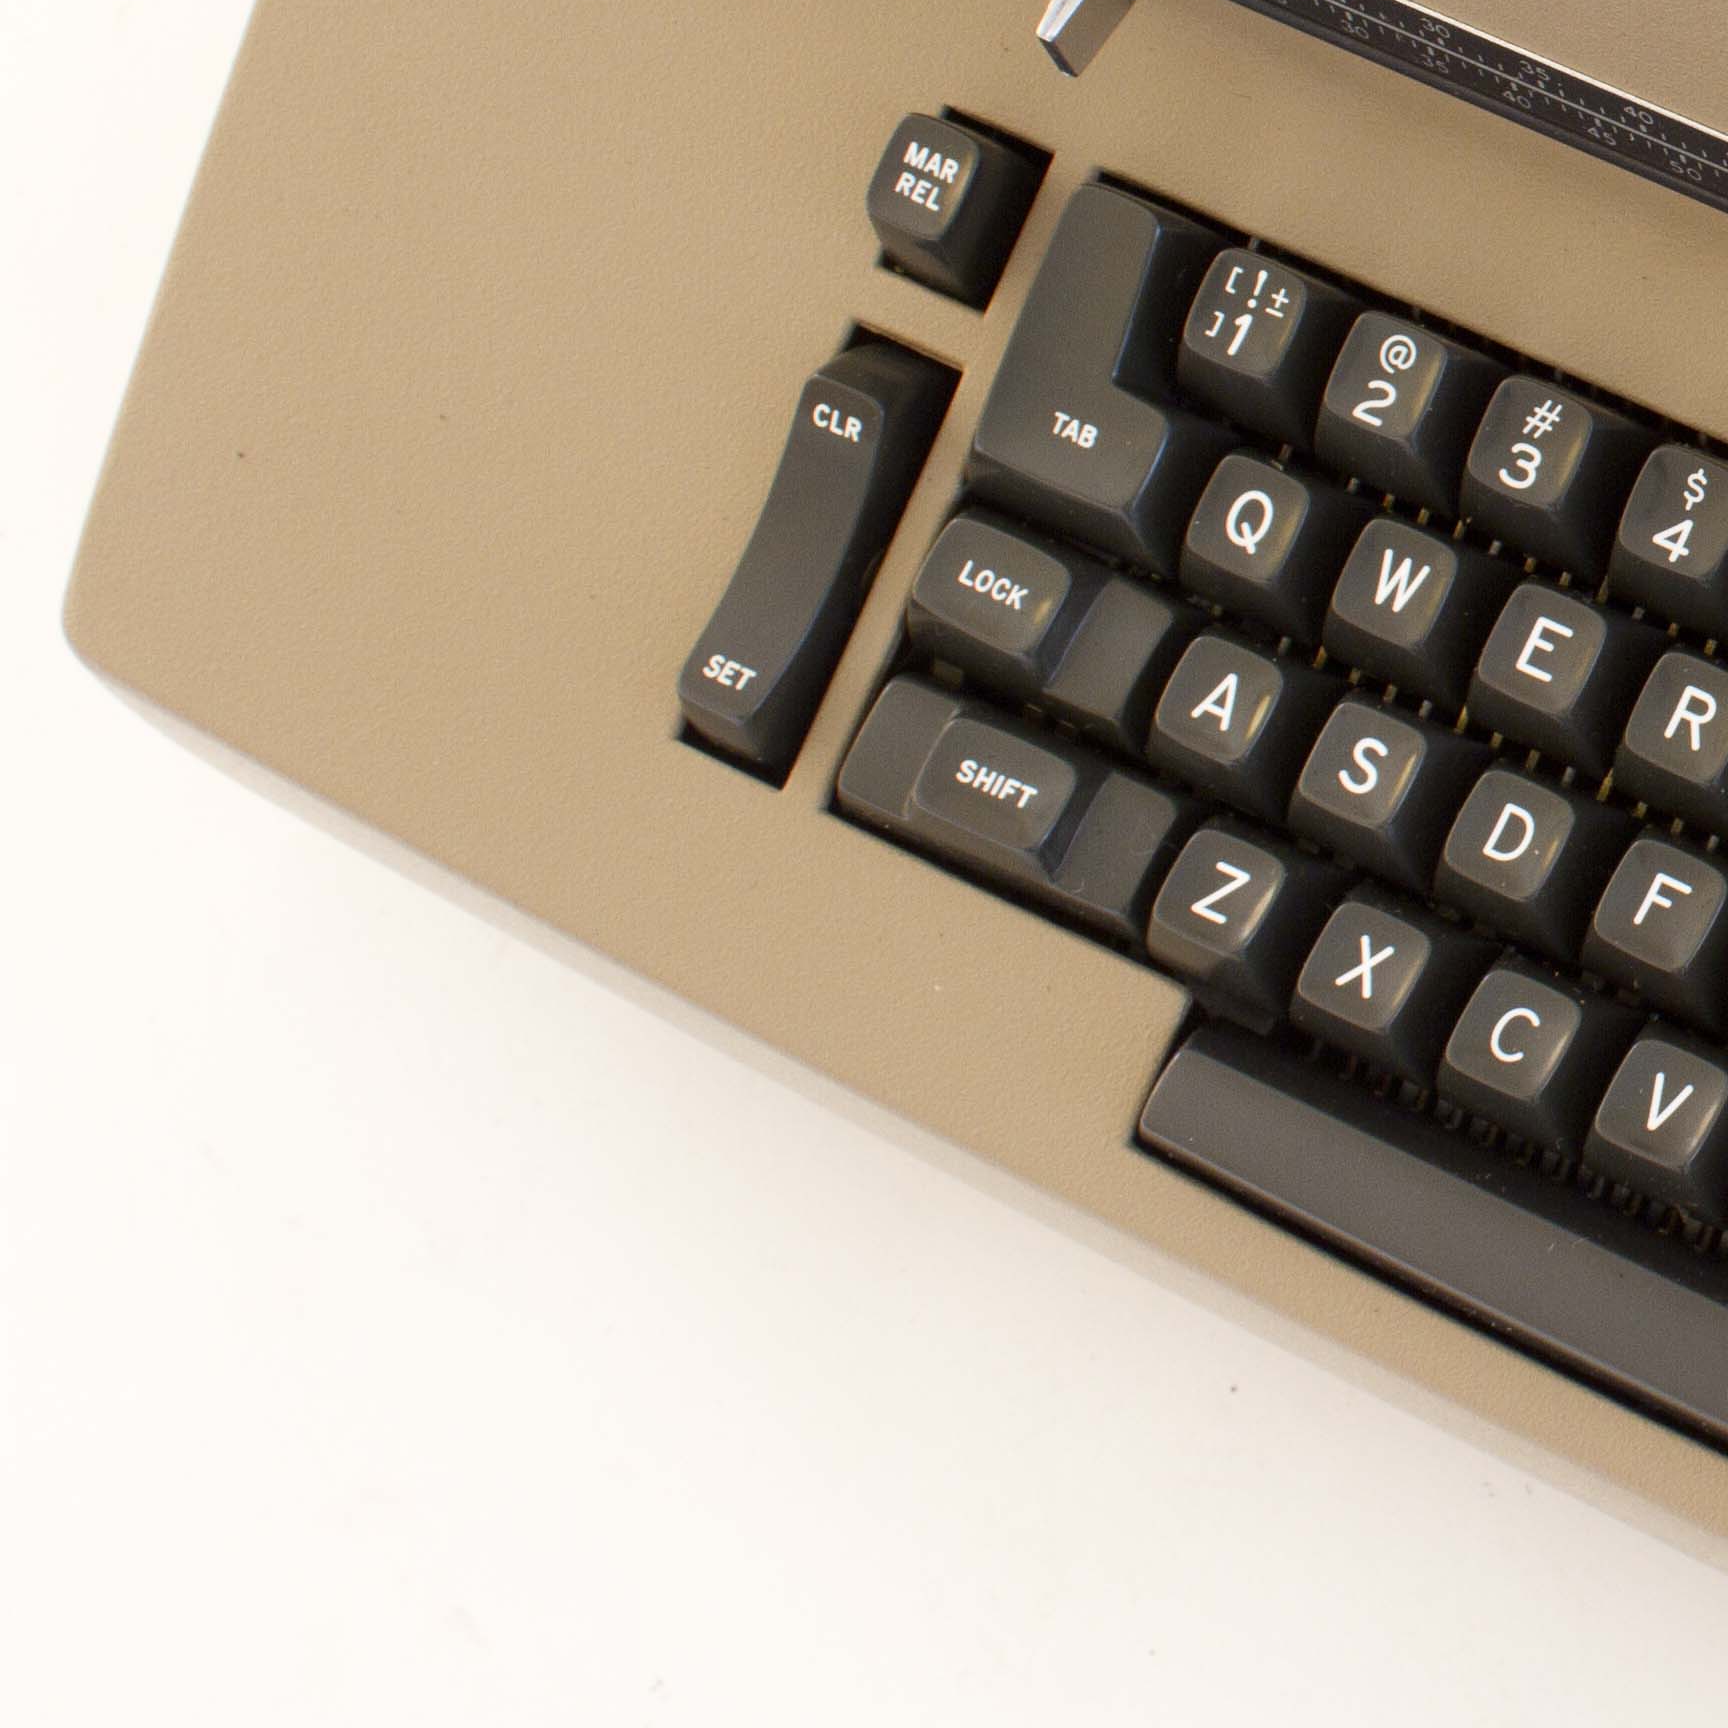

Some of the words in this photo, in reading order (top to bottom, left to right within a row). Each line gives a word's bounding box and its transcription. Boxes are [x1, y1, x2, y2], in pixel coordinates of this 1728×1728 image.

[1420, 18, 1450, 38] 30
[1519, 60, 1551, 82] 35
[1624, 105, 1654, 126] 40
[1341, 21, 1370, 40] 30
[1420, 57, 1448, 75] 35
[1502, 90, 1531, 110] 40
[1587, 127, 1617, 147] 45
[1670, 161, 1702, 181] 50
[904, 141, 960, 183] MAR
[894, 172, 939, 212] REL
[1379, 334, 1417, 374] @
[812, 403, 862, 442] CLR
[1052, 411, 1098, 449] TAB
[1352, 380, 1397, 427] 2
[1522, 399, 1563, 439] #
[1498, 442, 1542, 489] 3
[1683, 468, 1708, 511] $
[1226, 490, 1274, 555] Q
[1652, 519, 1694, 563] 4
[958, 560, 1029, 610] LOCK
[1374, 548, 1431, 613] W
[702, 654, 757, 690] SET
[1515, 616, 1574, 683] E
[1191, 673, 1238, 732] A
[1664, 685, 1717, 751] R
[955, 759, 1038, 809] SHIFT
[1338, 737, 1388, 794] S
[1482, 803, 1535, 862] D
[1191, 861, 1251, 925] Z
[1633, 872, 1693, 925] F
[1335, 934, 1395, 999] X
[1490, 1007, 1541, 1063] C
[1646, 1072, 1694, 1131] V
